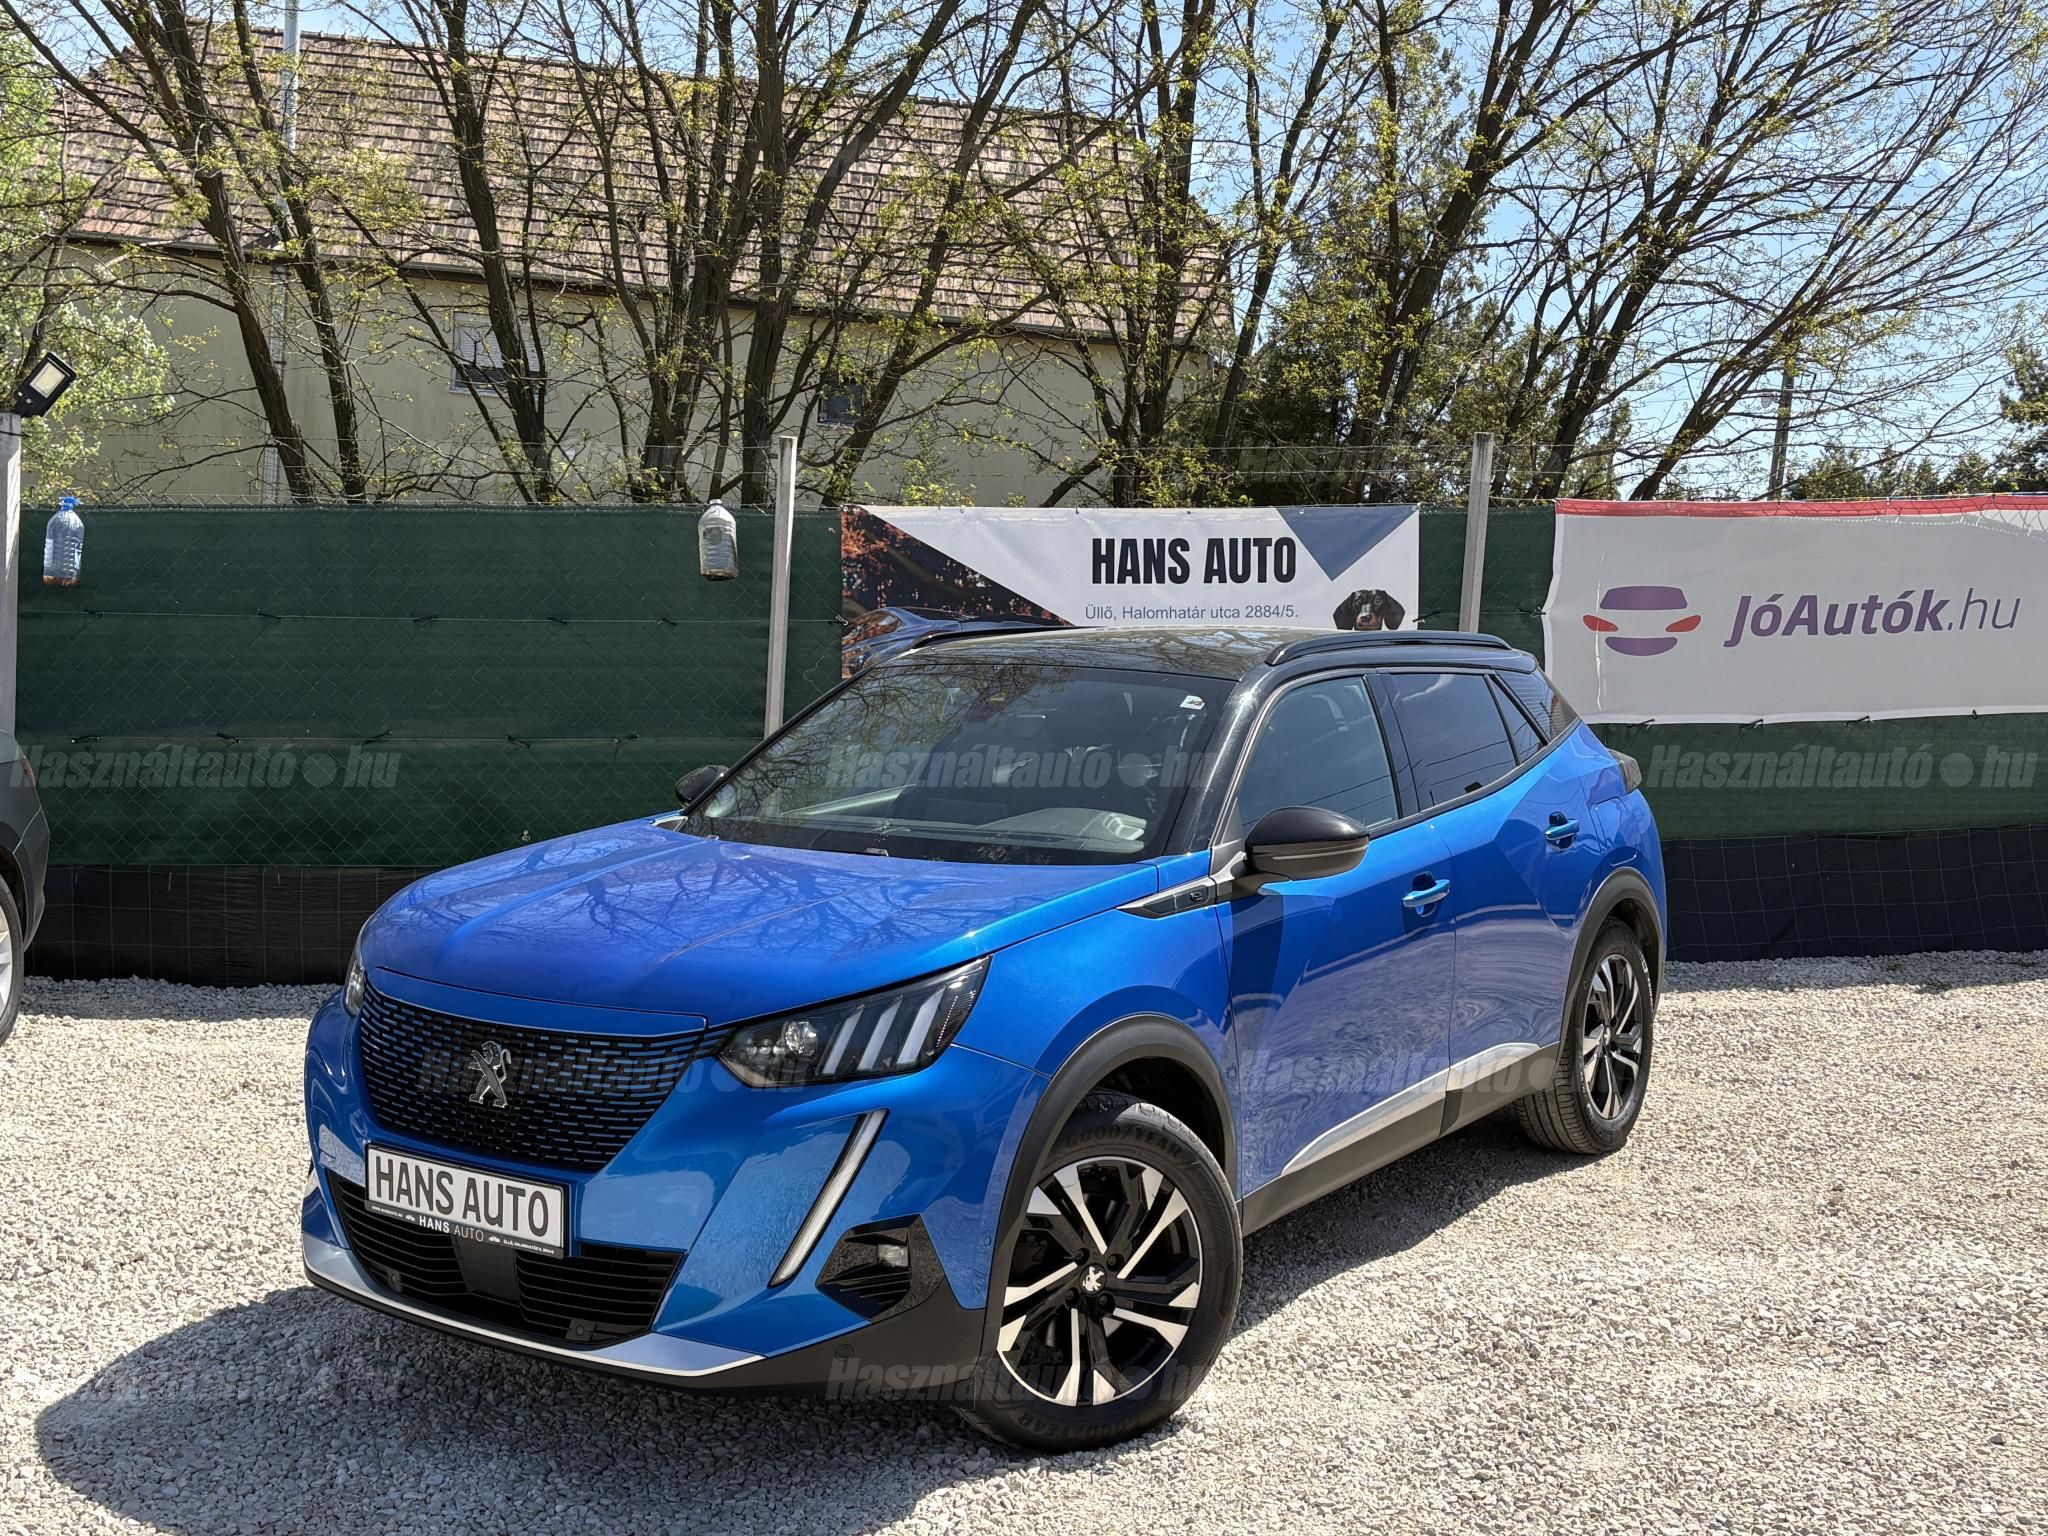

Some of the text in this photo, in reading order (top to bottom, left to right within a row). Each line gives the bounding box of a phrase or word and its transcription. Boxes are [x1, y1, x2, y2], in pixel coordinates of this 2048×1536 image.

[1092, 537, 1296, 584] HANS AUTO
[1085, 604, 1298, 621] Üllő, Halomhatár utca 2884/5.
[1723, 587, 2021, 648] JóAutók.hu
[375, 1155, 549, 1237] HANS AUTO
[419, 1215, 484, 1242] HANS AUTO
